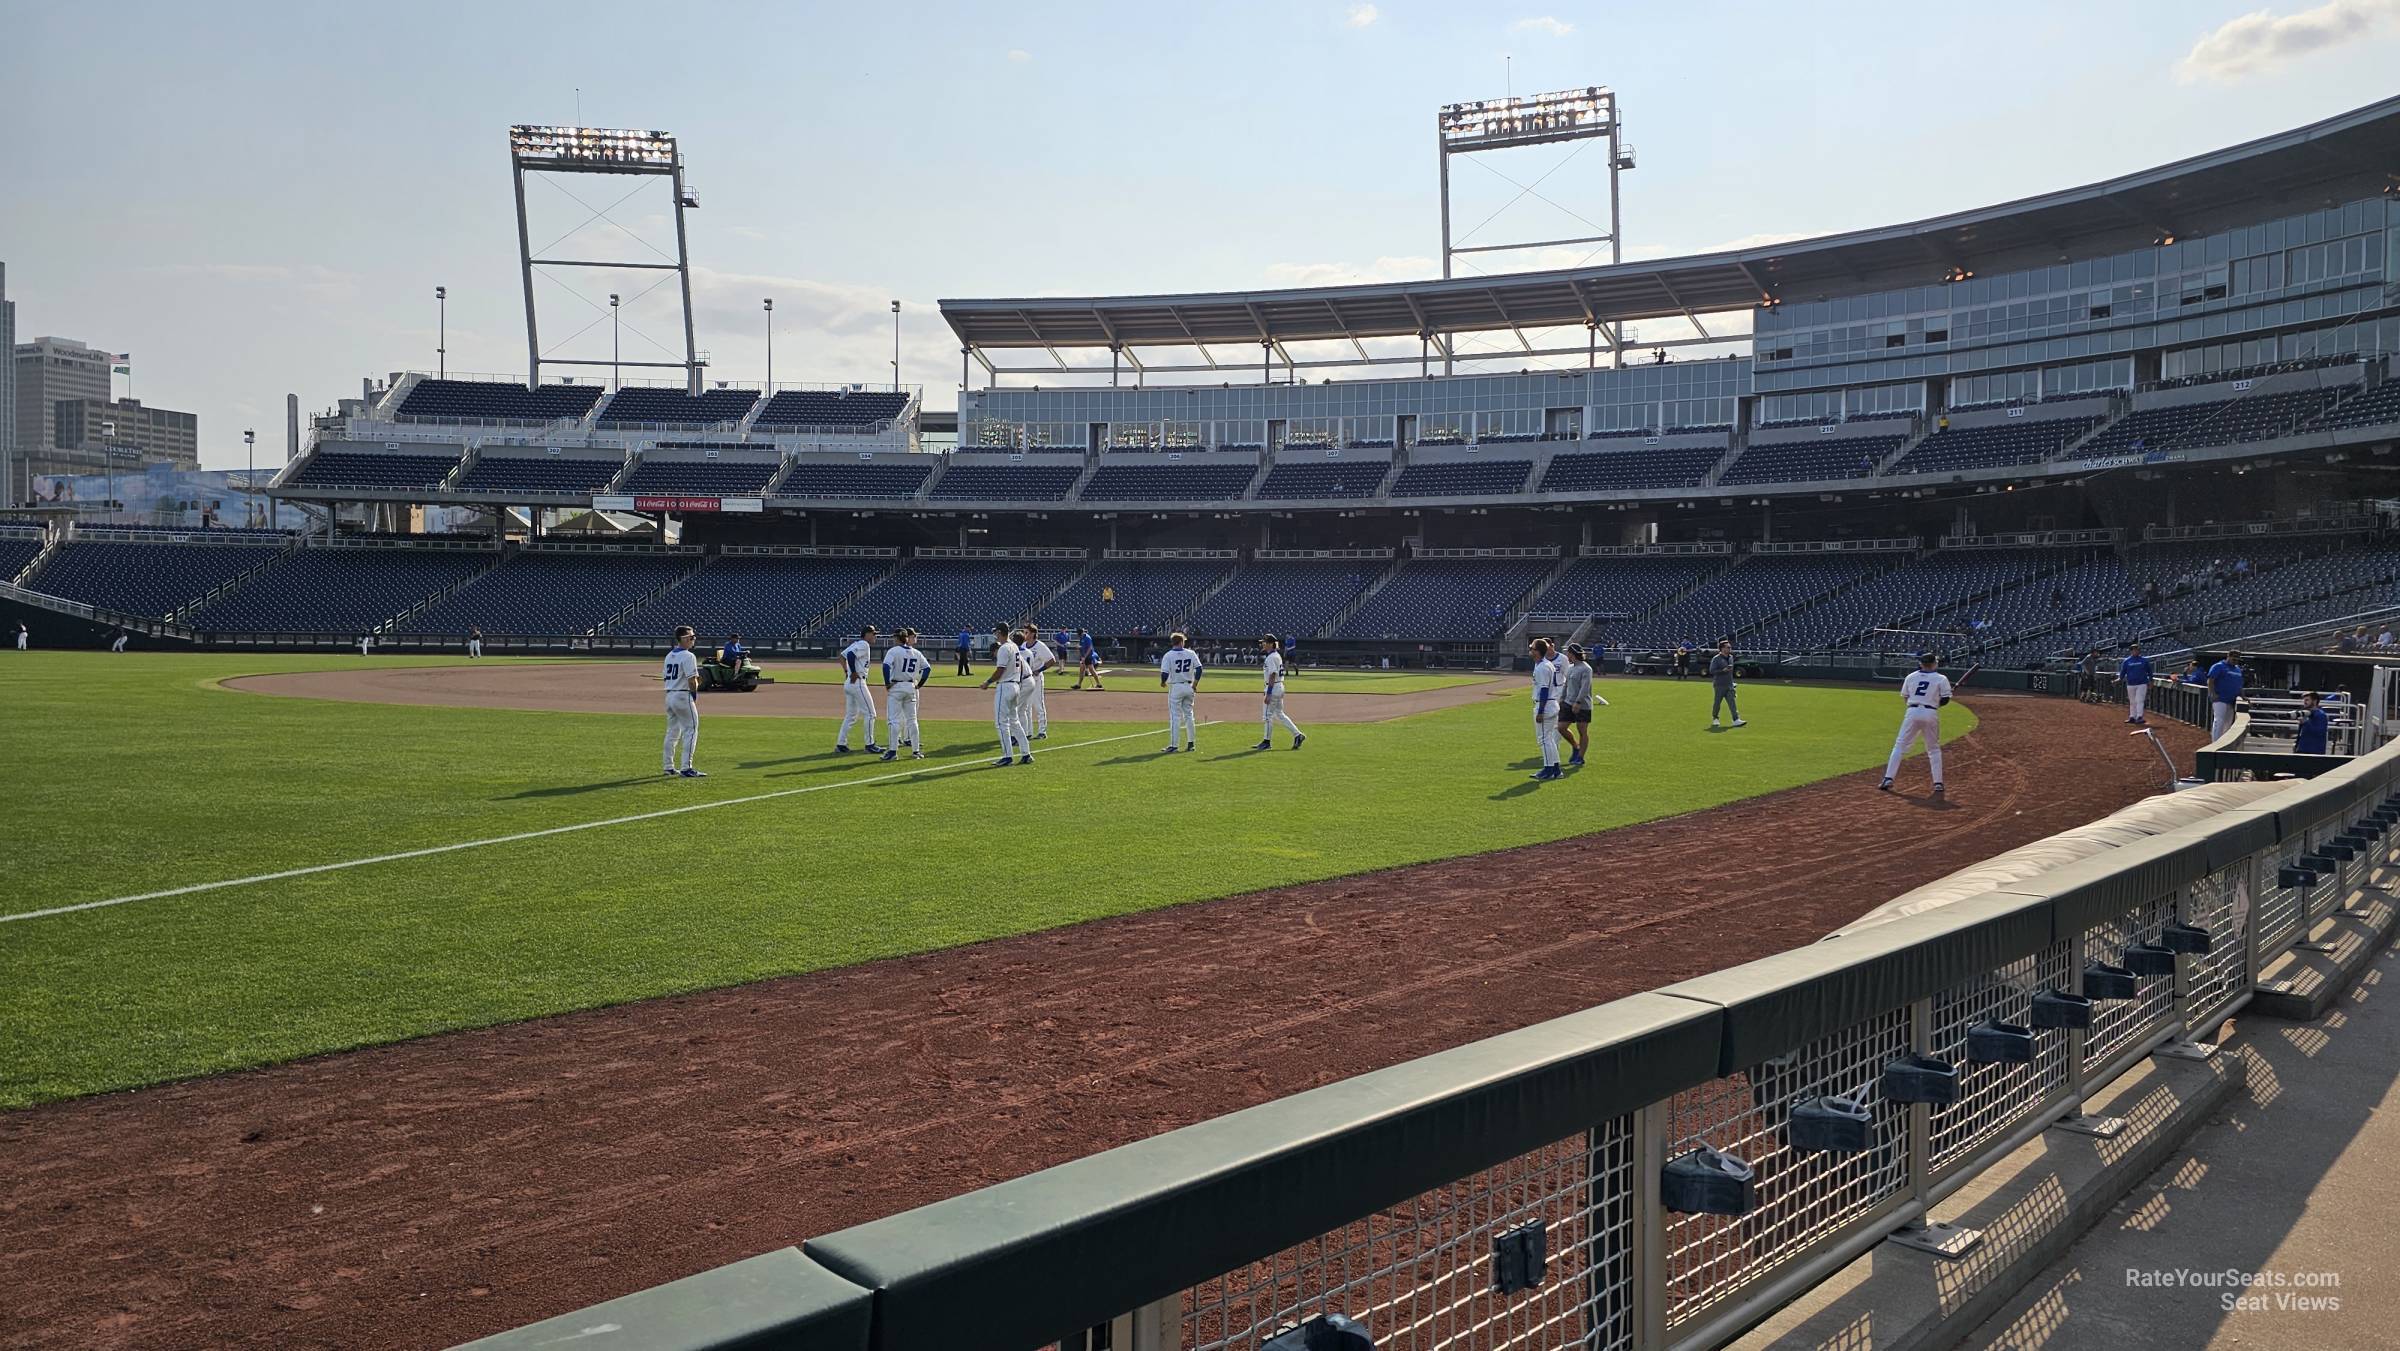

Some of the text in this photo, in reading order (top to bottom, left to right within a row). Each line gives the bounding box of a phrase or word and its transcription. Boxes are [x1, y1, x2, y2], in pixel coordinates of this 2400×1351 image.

[53, 347, 104, 361] WoodmenLife
[2235, 381, 2250, 390] 212
[665, 663, 679, 680] 20
[902, 658, 918, 673] 15
[1175, 659, 1192, 673] 32
[1914, 681, 1930, 696] 2
